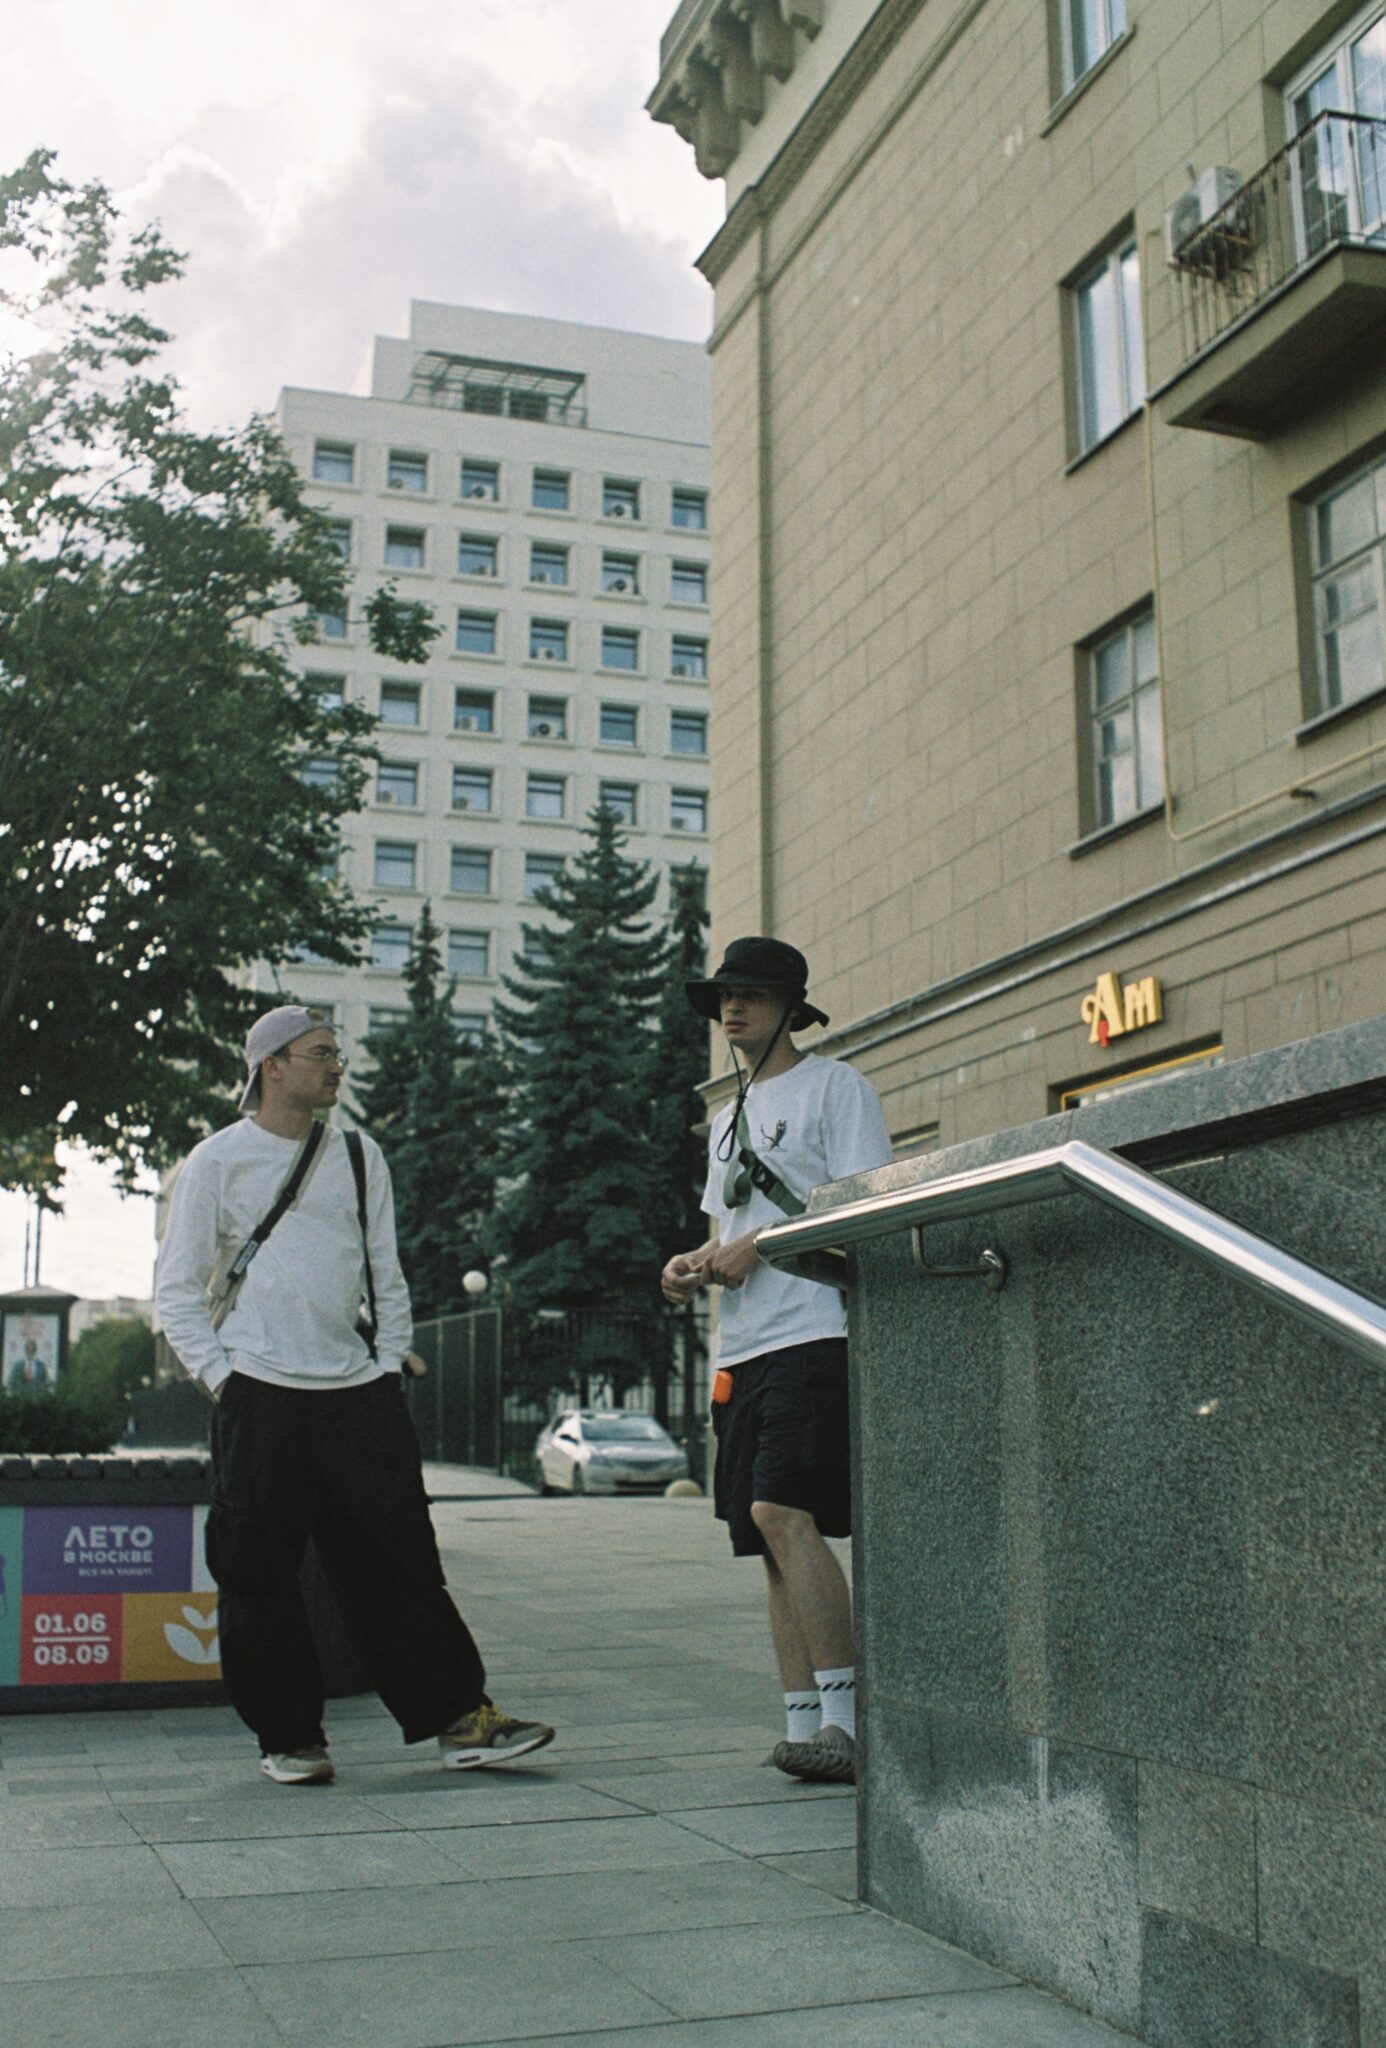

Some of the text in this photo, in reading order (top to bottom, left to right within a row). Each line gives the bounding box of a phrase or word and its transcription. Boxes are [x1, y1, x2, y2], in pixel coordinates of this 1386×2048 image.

[64, 1526, 153, 1548] ЛЕТО
[80, 1551, 153, 1563] МОСКВЕ
[35, 1613, 106, 1633] 01.06
[34, 1645, 108, 1665] 08.09
